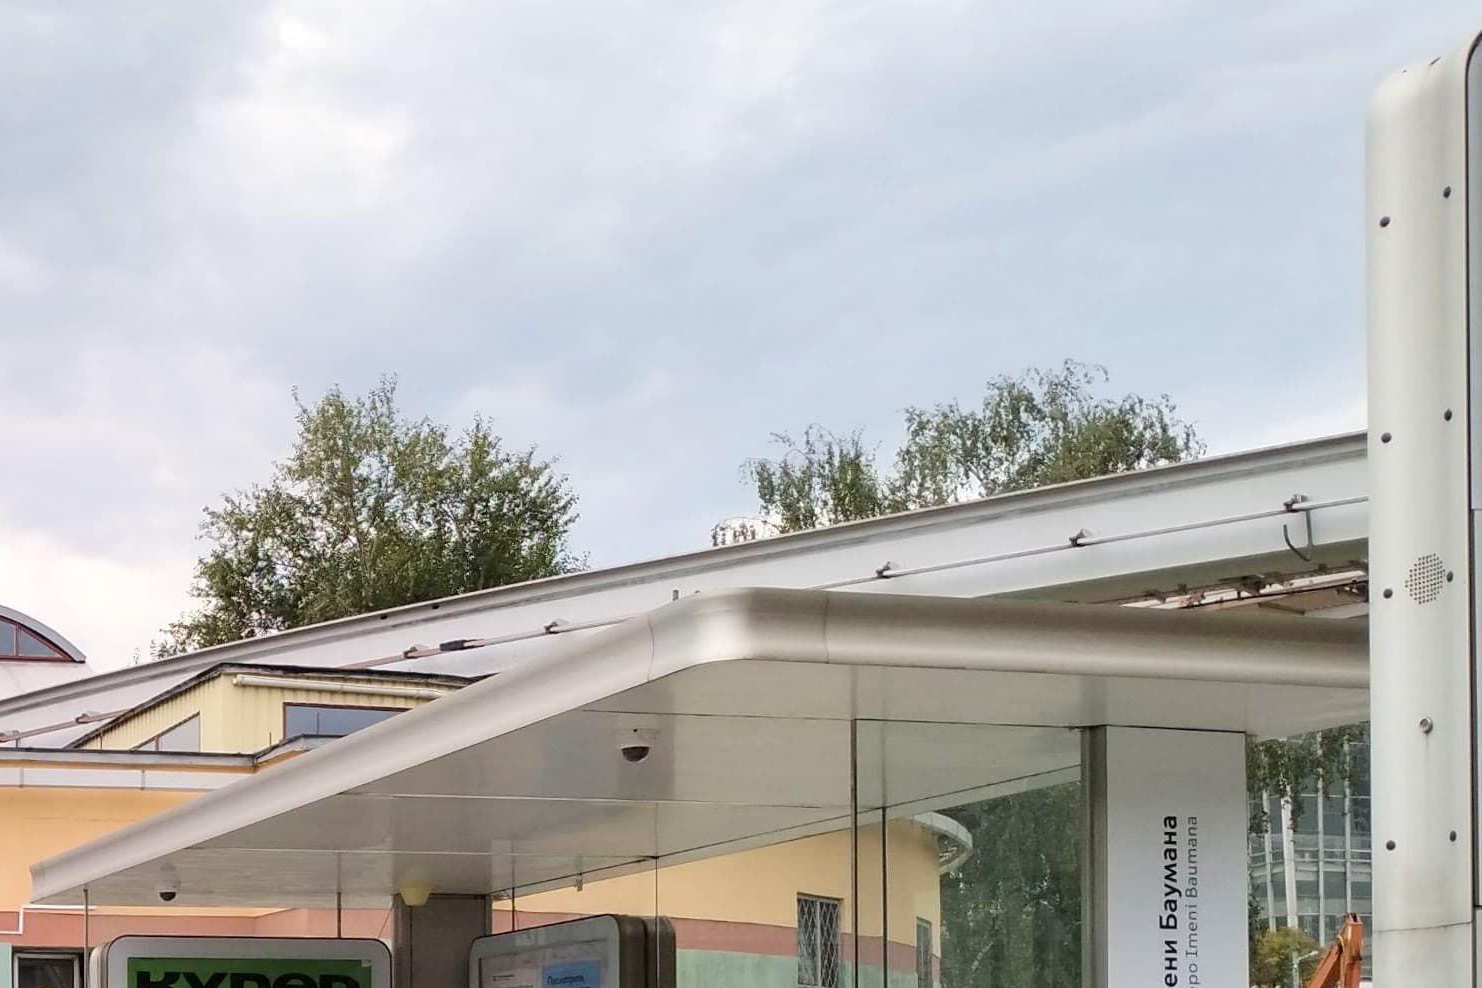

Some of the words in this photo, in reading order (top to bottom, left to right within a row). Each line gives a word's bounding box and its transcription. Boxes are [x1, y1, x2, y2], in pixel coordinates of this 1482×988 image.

[1159, 815, 1182, 931] Баумана
[1185, 816, 1198, 899] Baumana
[1185, 904, 1198, 958] Imeni
